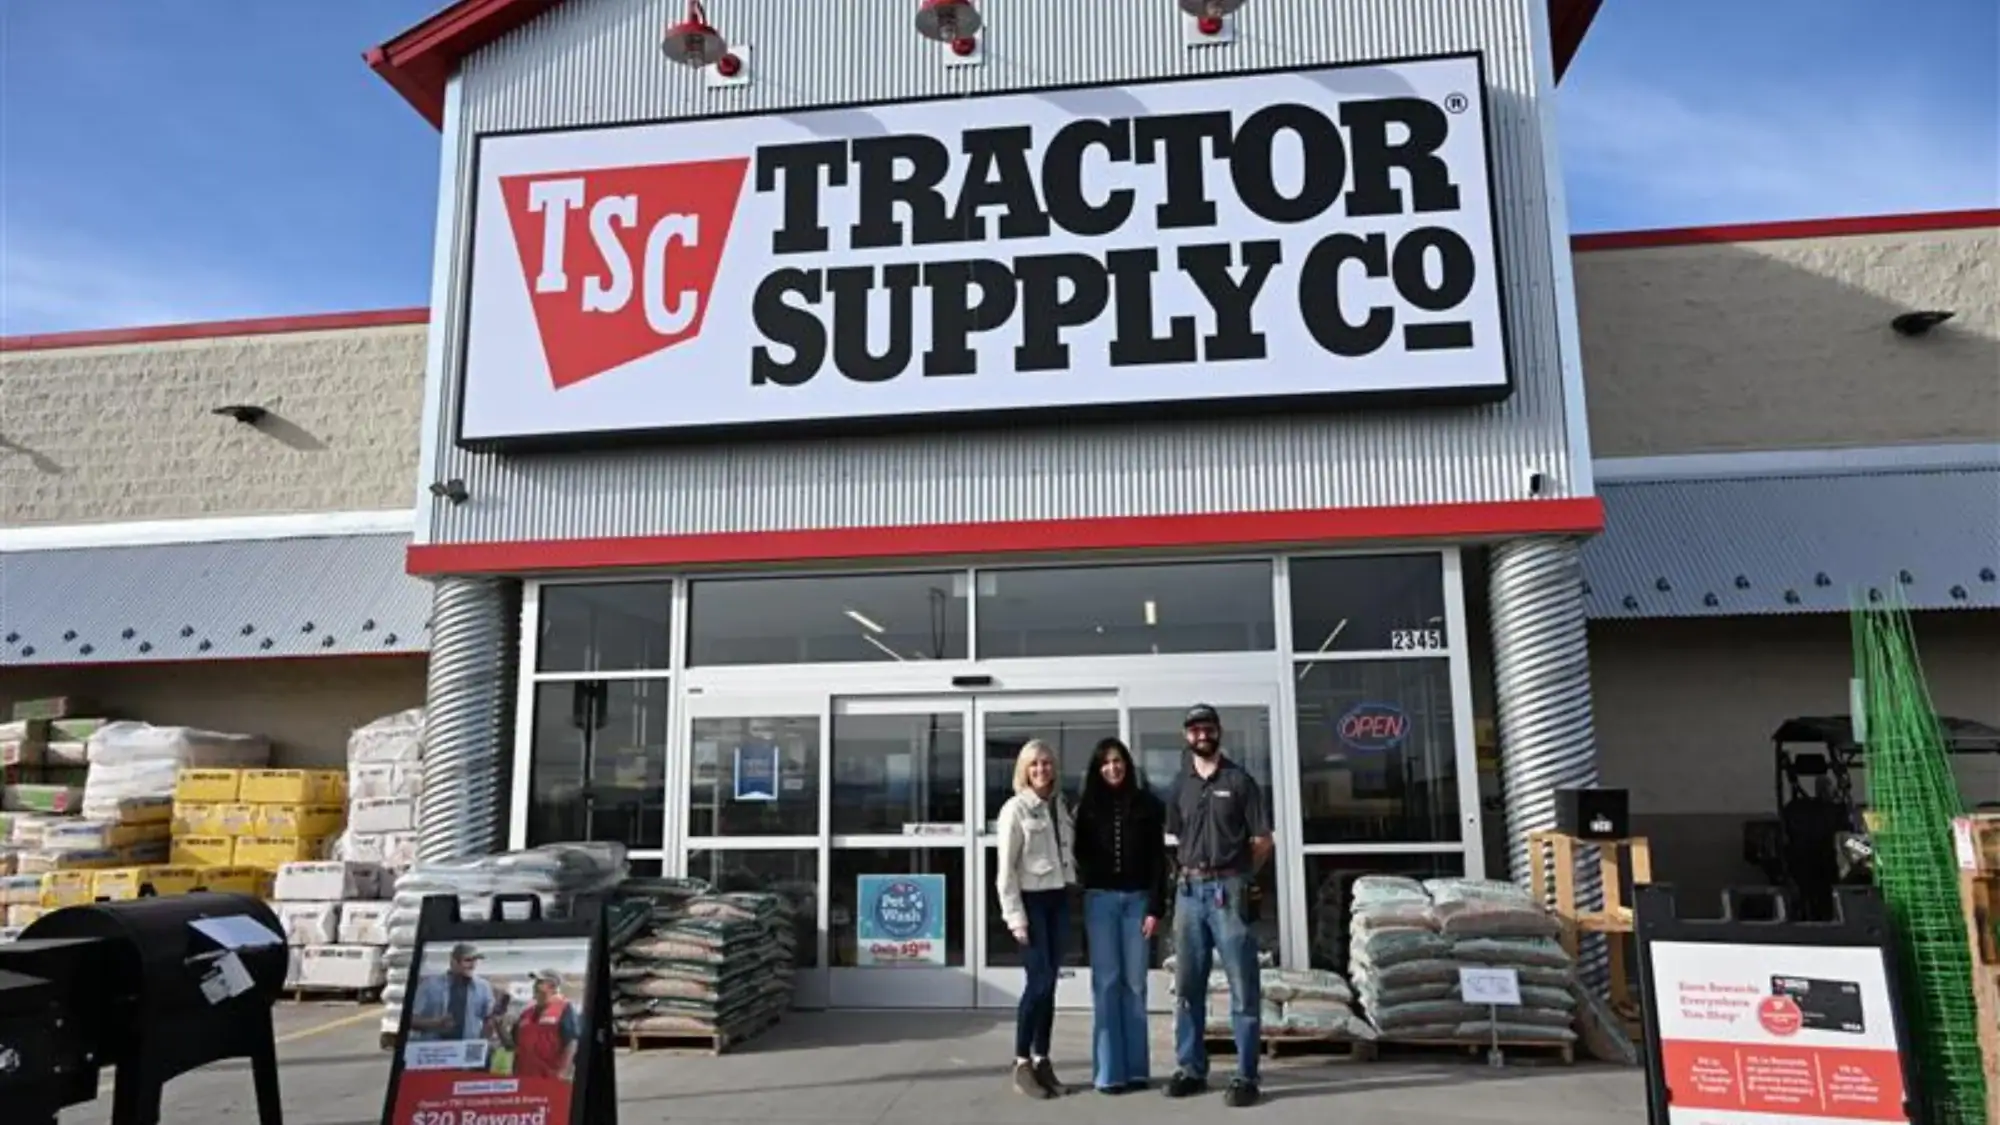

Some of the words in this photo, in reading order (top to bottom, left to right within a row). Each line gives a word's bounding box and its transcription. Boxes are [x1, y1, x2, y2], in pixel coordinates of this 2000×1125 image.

[754, 97, 1460, 255] TRACTOR
[527, 177, 701, 338] TSC
[751, 239, 1281, 387] SUPPLY
[1393, 631, 1440, 650] 2345
[1342, 715, 1403, 739] OPEN
[880, 908, 921, 923] Wash
[412, 1110, 454, 1125] $20
